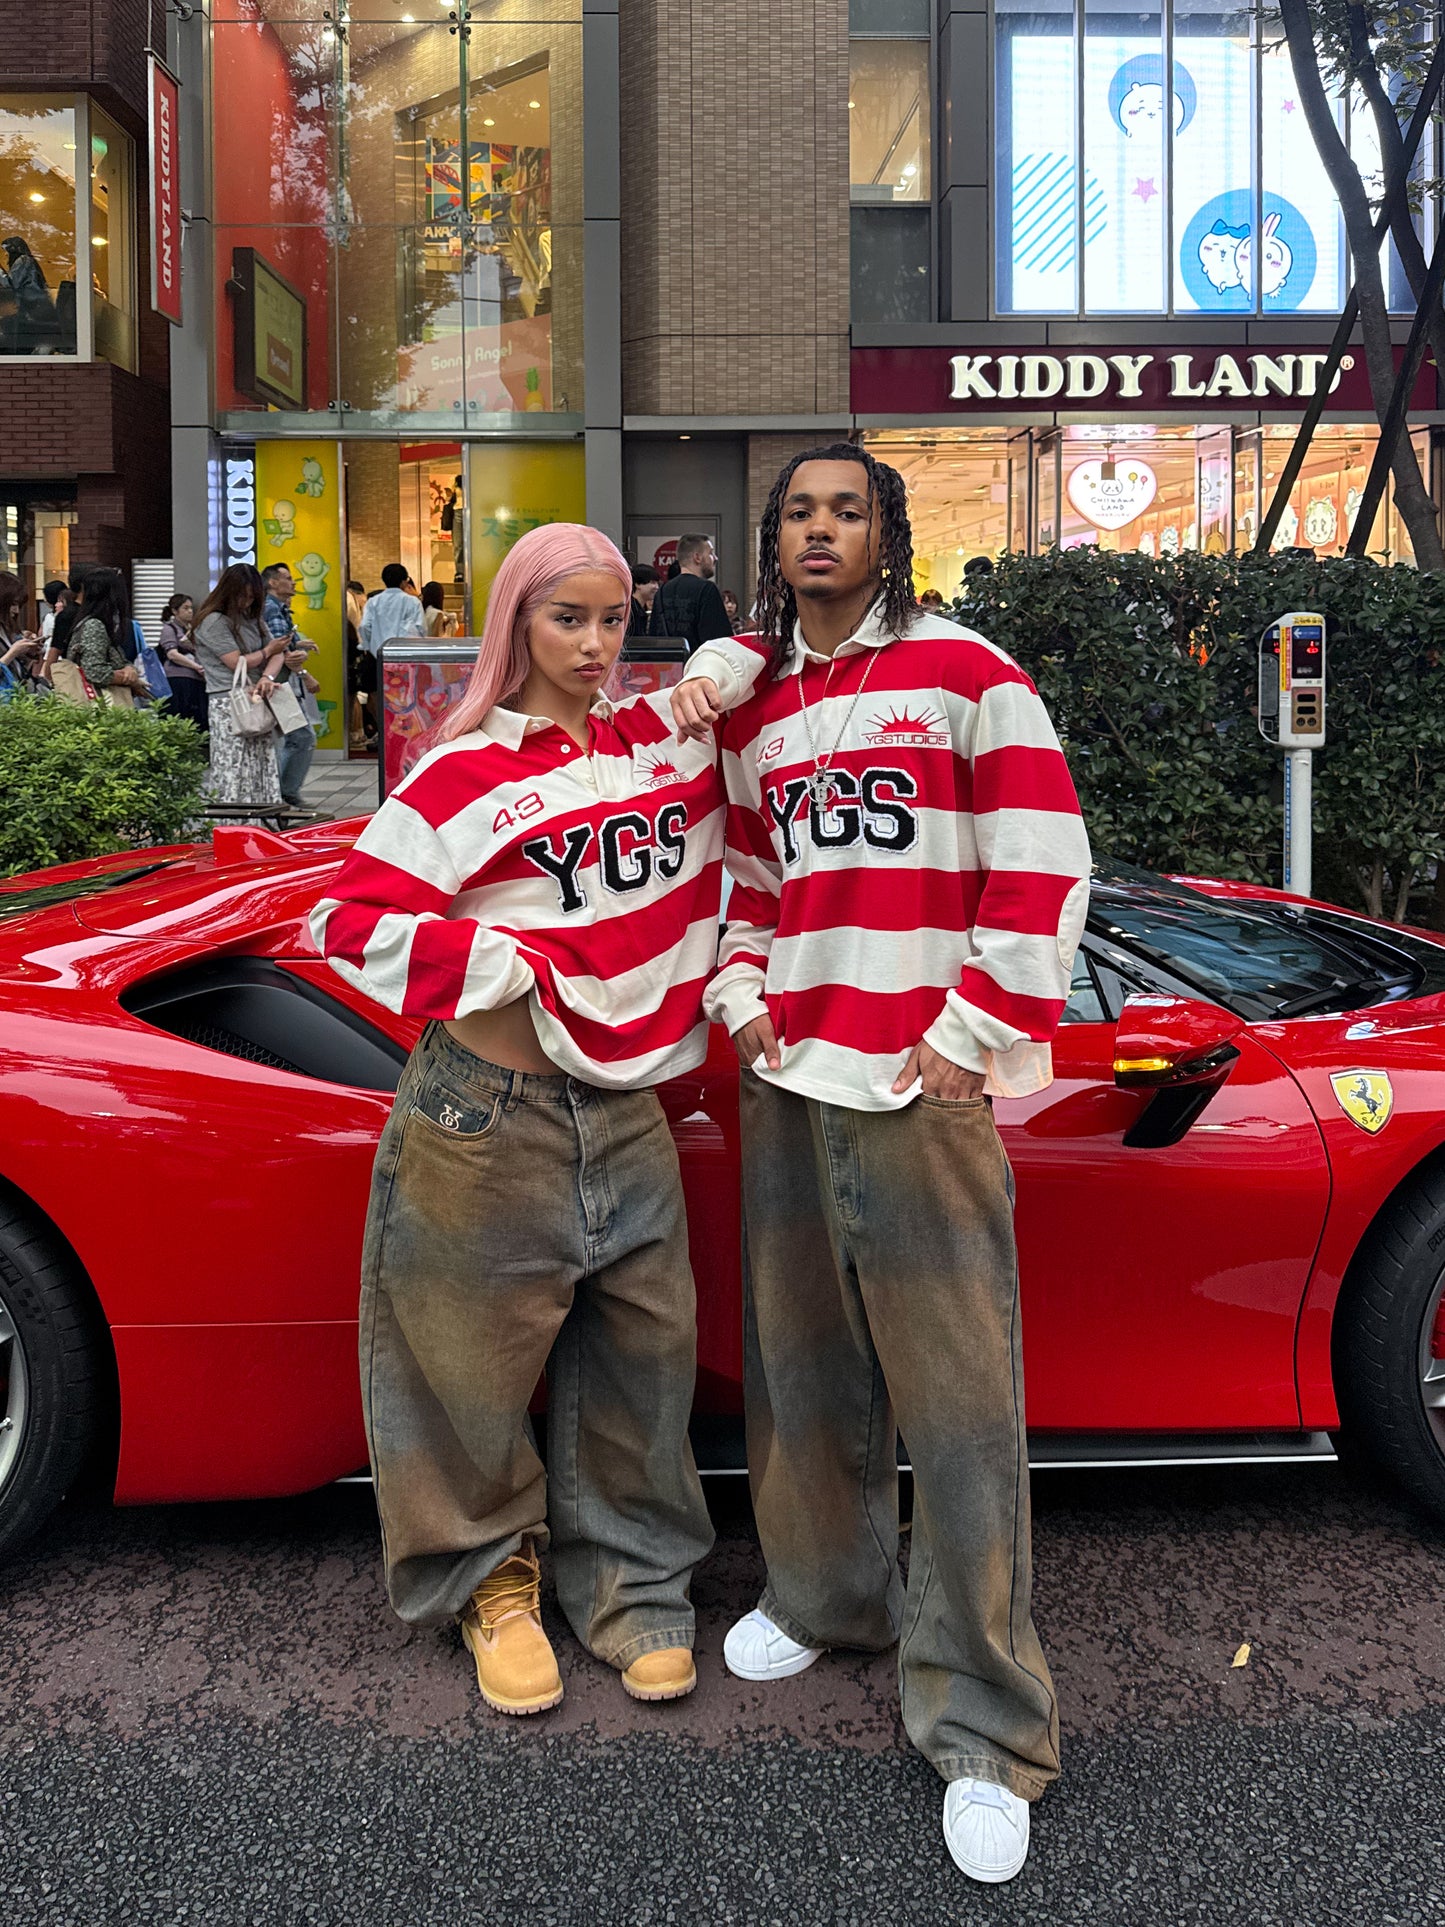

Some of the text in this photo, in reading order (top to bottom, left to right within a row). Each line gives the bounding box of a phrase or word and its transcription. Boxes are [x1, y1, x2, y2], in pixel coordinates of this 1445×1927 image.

[160, 92, 172, 289] KIDDY LAND
[431, 340, 512, 371] Sonny Angel
[950, 354, 1342, 399] KIDDY LAND
[866, 734, 947, 746] YGSTUDIOS
[493, 792, 545, 834] 43
[767, 766, 918, 867] YGS
[521, 801, 688, 915] YGS
